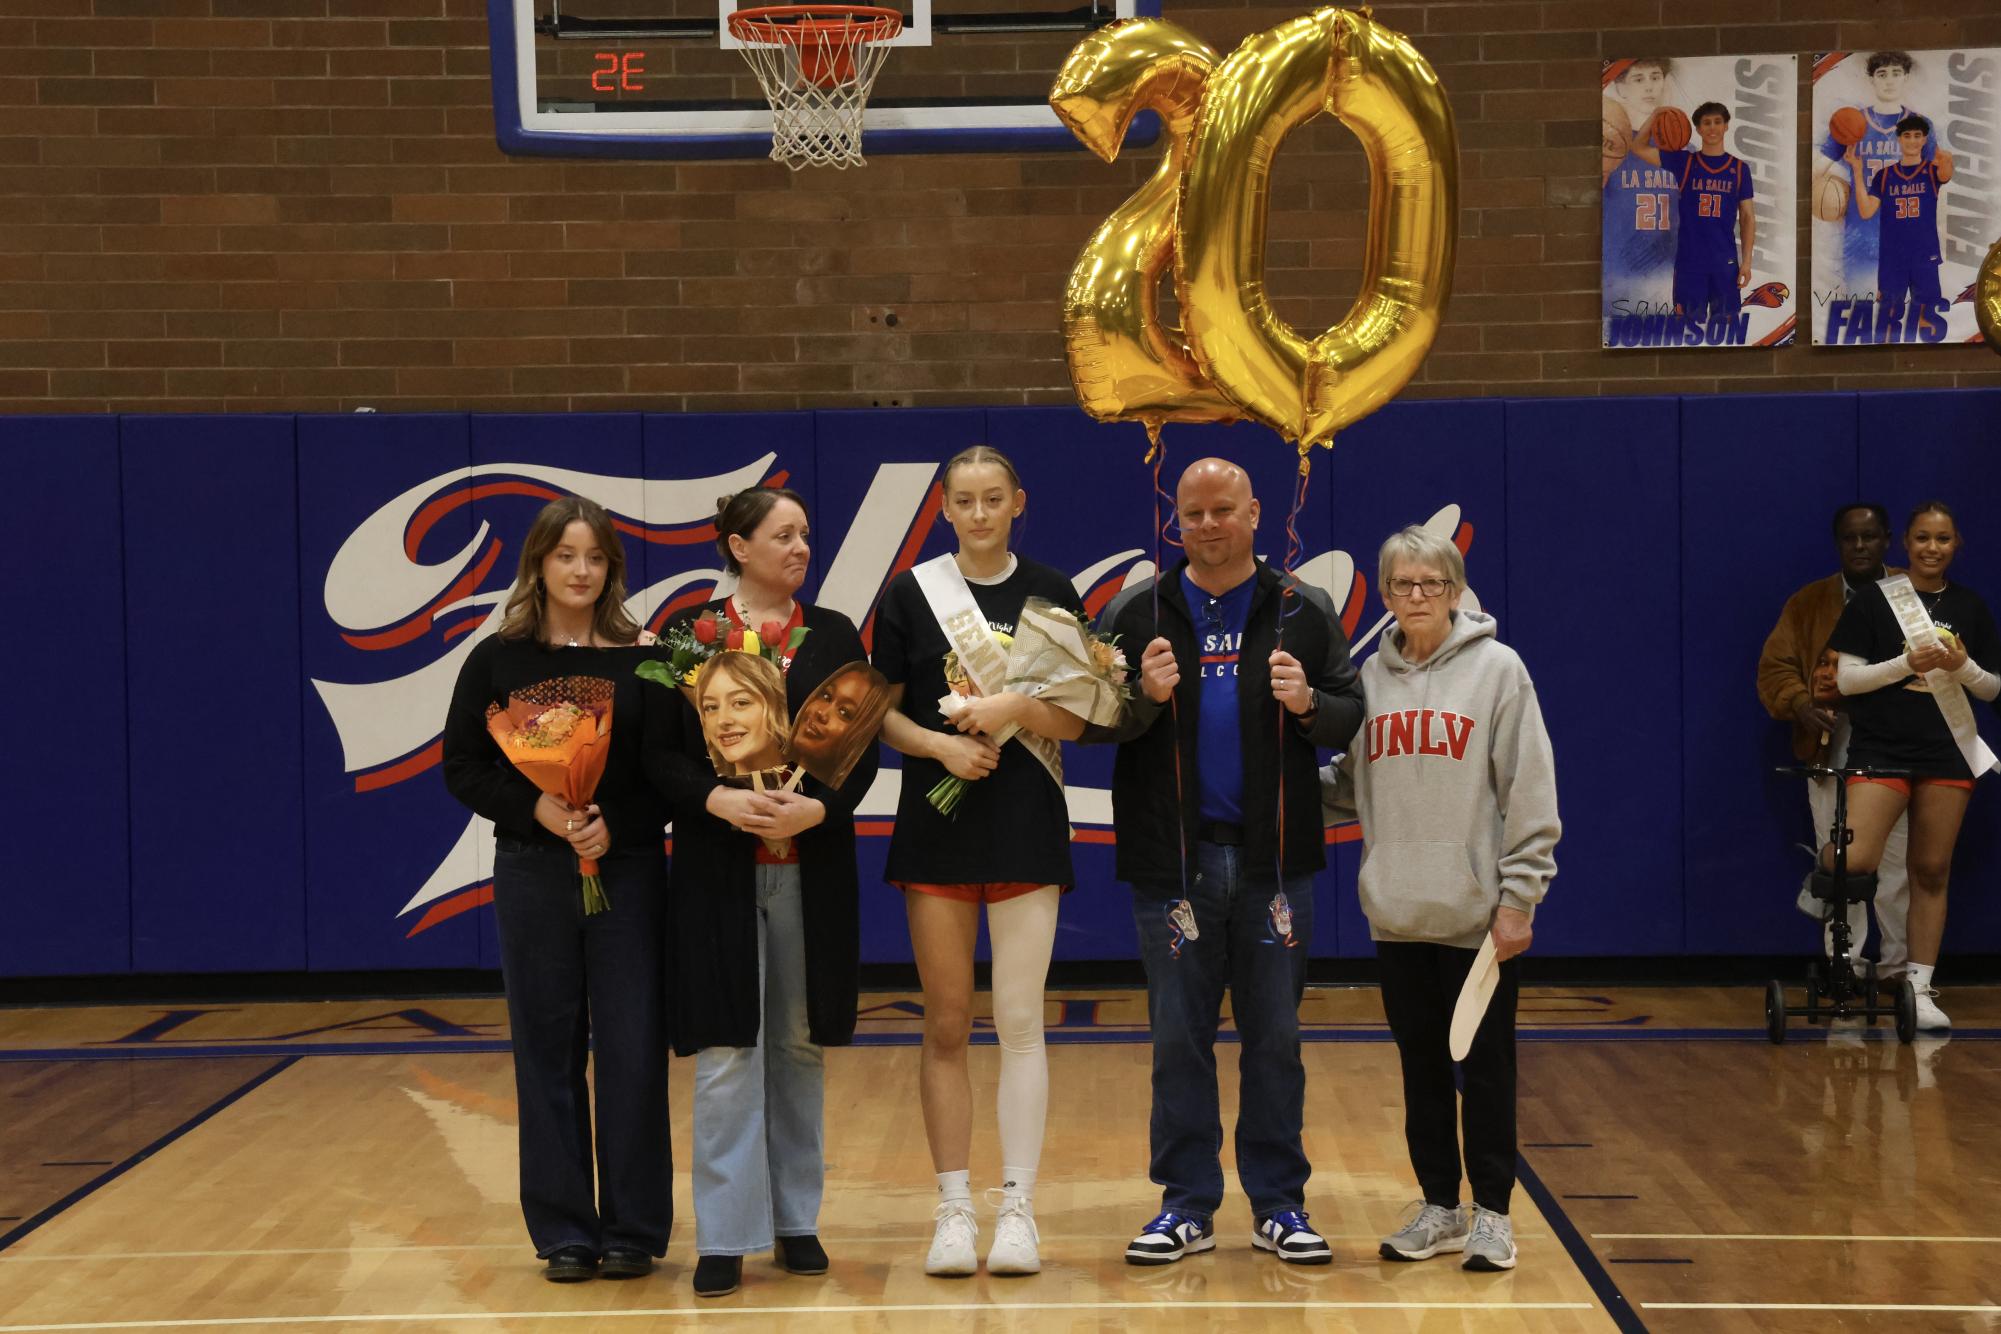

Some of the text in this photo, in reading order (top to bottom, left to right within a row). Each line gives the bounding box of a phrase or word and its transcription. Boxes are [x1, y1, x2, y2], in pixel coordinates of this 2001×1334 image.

[1621, 170, 1679, 190] LA SALL
[1946, 52, 1996, 268] FALCONS
[1049, 5, 1459, 440] 20
[1635, 193, 1670, 230] 21
[1698, 193, 1722, 217] 21
[1609, 311, 1750, 347] JOHNSON
[1826, 297, 1950, 345] FARIS
[1366, 708, 1475, 764] UNLV
